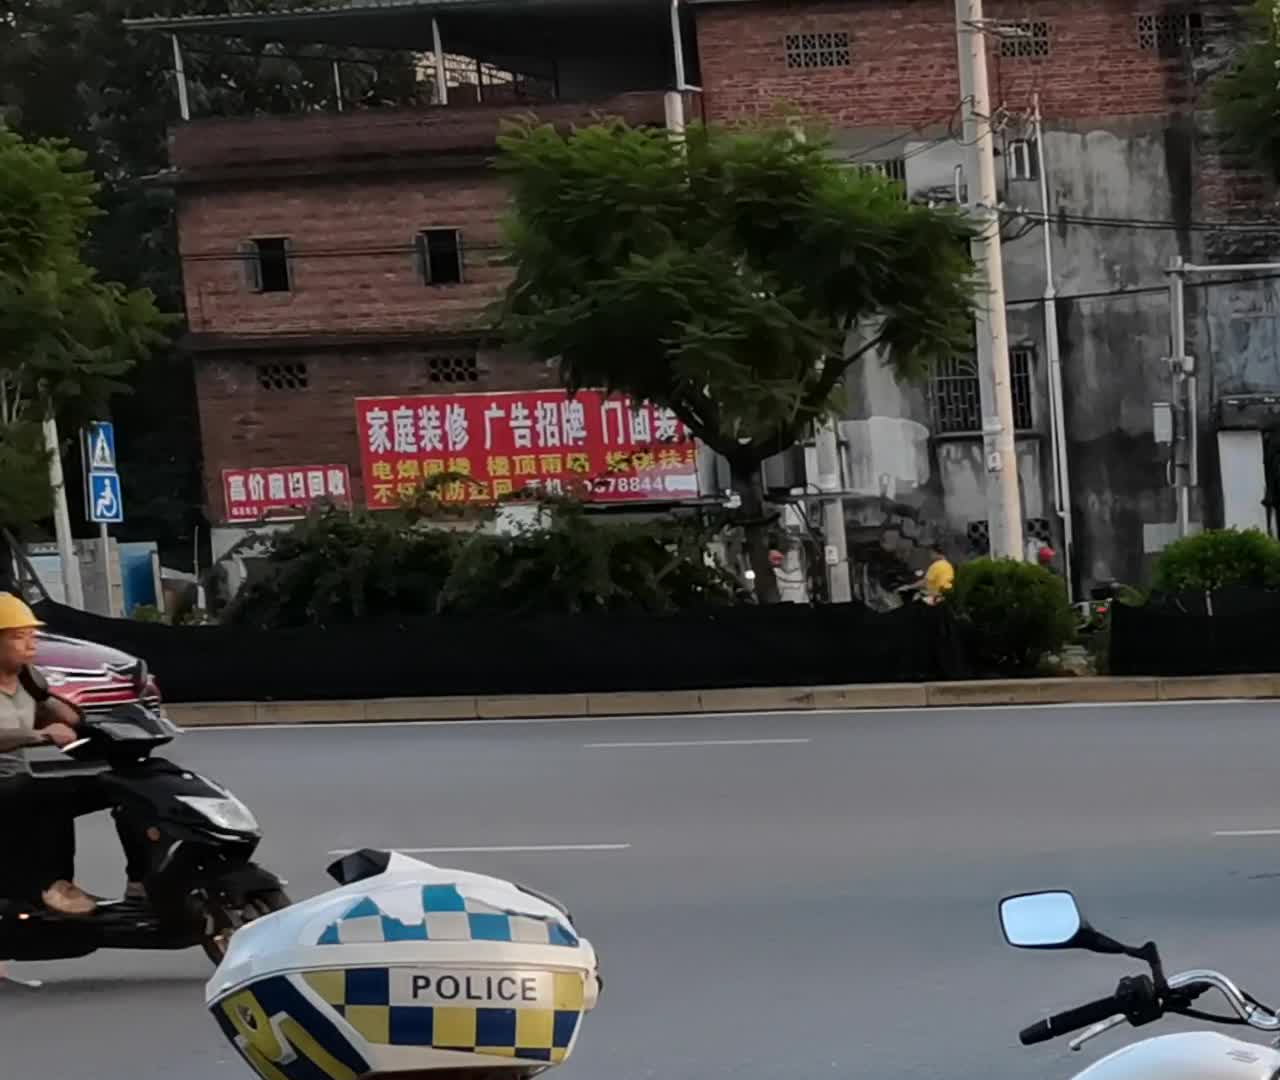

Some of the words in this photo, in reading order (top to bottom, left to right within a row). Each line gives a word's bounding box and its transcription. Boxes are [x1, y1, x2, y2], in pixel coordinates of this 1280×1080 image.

[365, 404, 470, 454] 家庭装修
[483, 400, 587, 449] 广告招牌
[601, 398, 693, 445] 门面装
[412, 975, 537, 1001] POLICE
